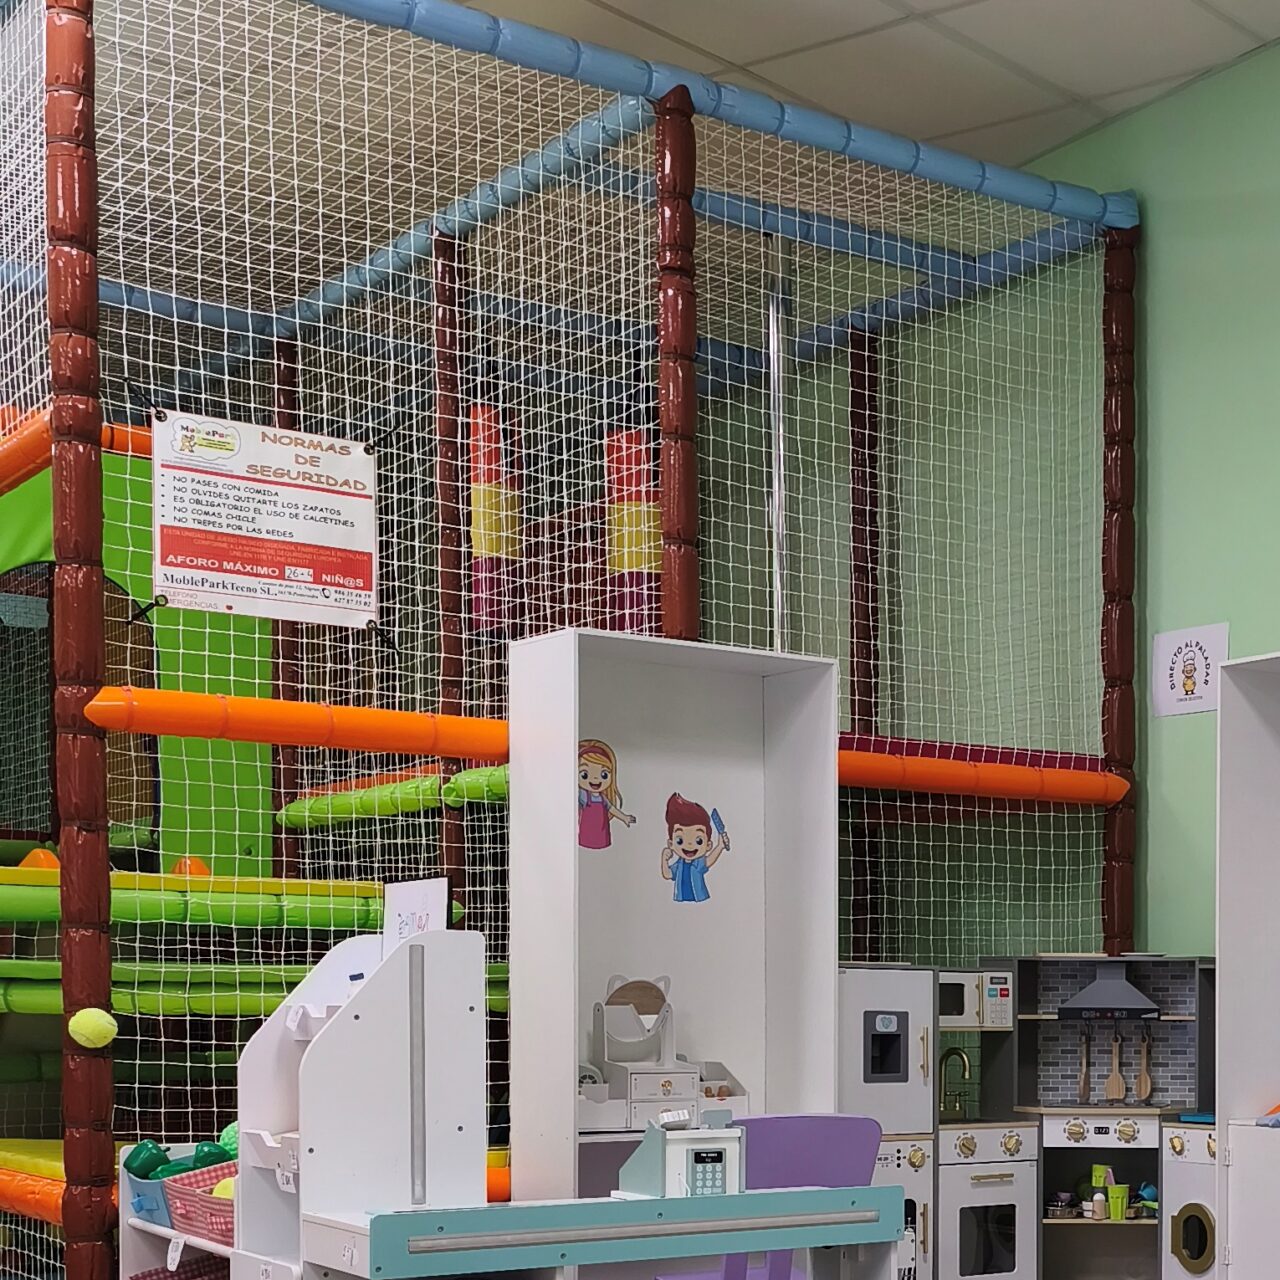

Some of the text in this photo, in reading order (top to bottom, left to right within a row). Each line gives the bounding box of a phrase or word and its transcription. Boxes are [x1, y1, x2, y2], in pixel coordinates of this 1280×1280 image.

[261, 431, 352, 456] NORMAS
[294, 453, 321, 468] DE
[191, 478, 219, 488] PASES
[222, 483, 240, 491] CON
[244, 487, 279, 497] COMIDA
[245, 464, 367, 491] SEGURIDAD
[189, 498, 250, 512] OBLIGATORIO
[253, 507, 263, 515] EL
[266, 510, 286, 518] USO
[289, 512, 301, 520] DE
[303, 514, 355, 528] CALCETINES
[191, 488, 230, 500] OLVIDES
[233, 495, 278, 507] QUITARTE
[281, 502, 299, 510] LOS
[303, 504, 341, 516] ZAPATOS
[191, 508, 222, 519] COMAS
[226, 513, 257, 524] CHICLE
[192, 518, 224, 529] TREPES
[226, 523, 243, 531] POR
[246, 526, 263, 535] LAS
[266, 529, 294, 538] REDES
[166, 554, 219, 568] AFORO
[222, 560, 279, 577] MÁXIMO
[321, 572, 364, 588] NIÑ@S
[167, 598, 218, 610] MERGENCIAS
[1169, 640, 1210, 690] DIRECTO AL PALADAR
